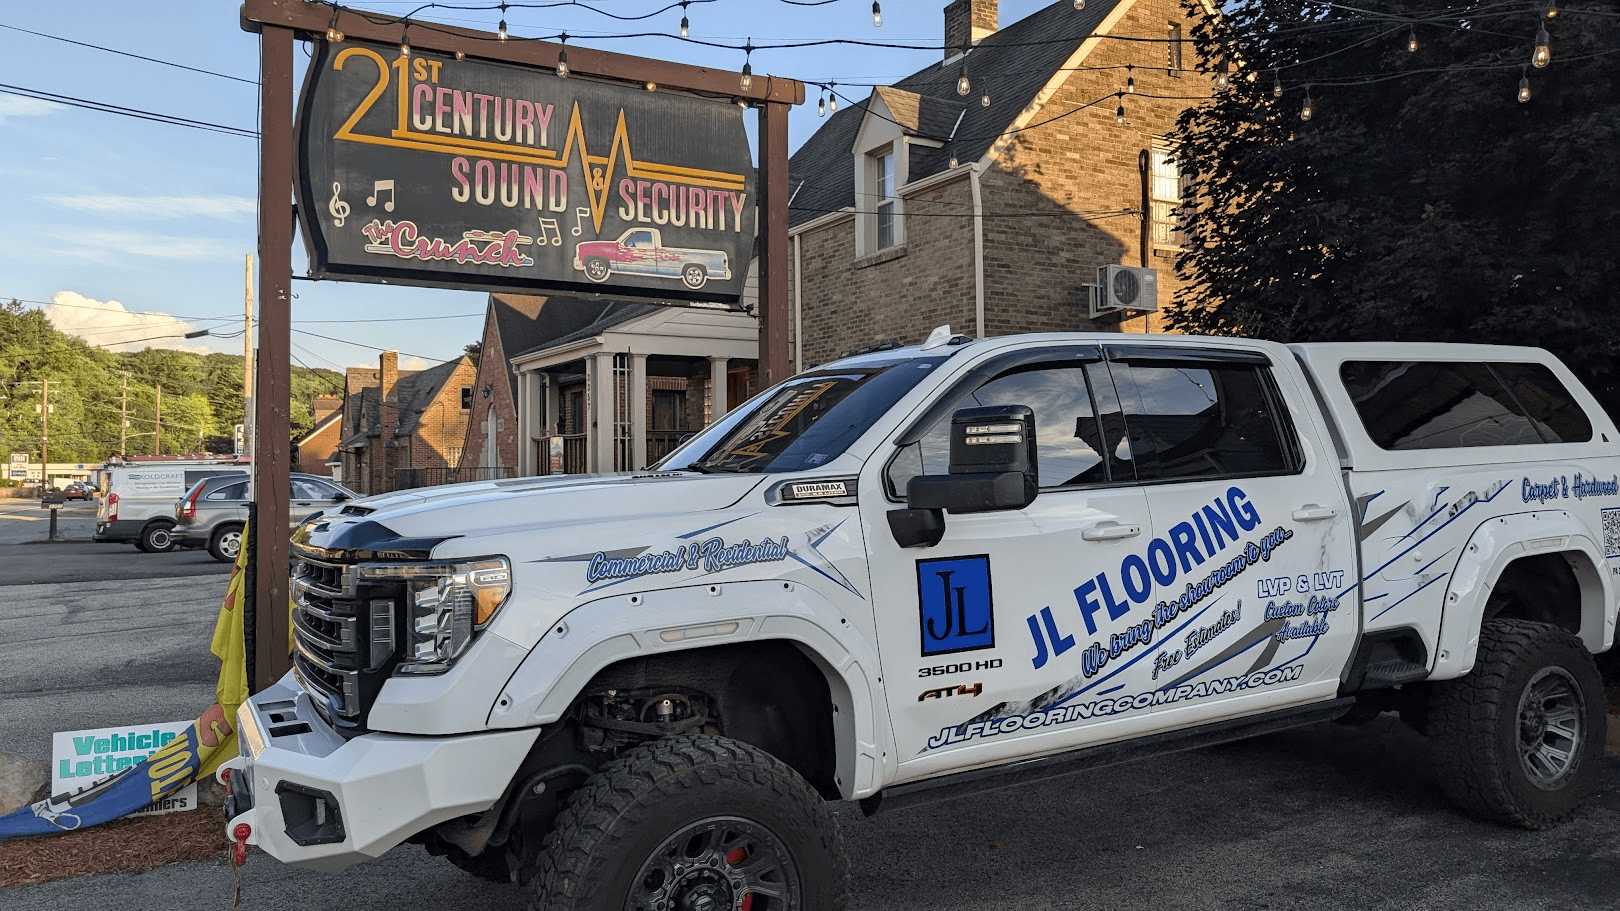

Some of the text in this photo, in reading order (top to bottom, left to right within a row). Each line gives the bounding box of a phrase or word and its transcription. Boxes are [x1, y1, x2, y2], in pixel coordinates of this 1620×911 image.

[413, 83, 554, 147] CENTURY
[451, 156, 747, 234] SOUND & SECURITY
[362, 219, 529, 266] The Crunch
[796, 483, 842, 492] DURAMAX
[1522, 472, 1620, 505] Carpet & Hardwood
[587, 536, 789, 583] Commercial & Residential
[1025, 486, 1263, 670] JL FLOORING
[927, 570, 988, 640] JL
[1257, 569, 1344, 599] LVP & LVT
[1081, 640, 1109, 678] We
[1109, 619, 1155, 660] bring
[1151, 599, 1179, 630] the
[1178, 553, 1247, 617] showroom
[1244, 541, 1261, 566] to
[1264, 594, 1341, 622] Custom Colors
[1275, 617, 1330, 643] Available
[1152, 599, 1242, 680] Free Estimates!
[918, 658, 1003, 678] 3500 HD
[918, 682, 983, 702] AT4
[926, 664, 1304, 750] JLFLOORINGCOMPANY.COM
[72, 729, 176, 757] Vehicle
